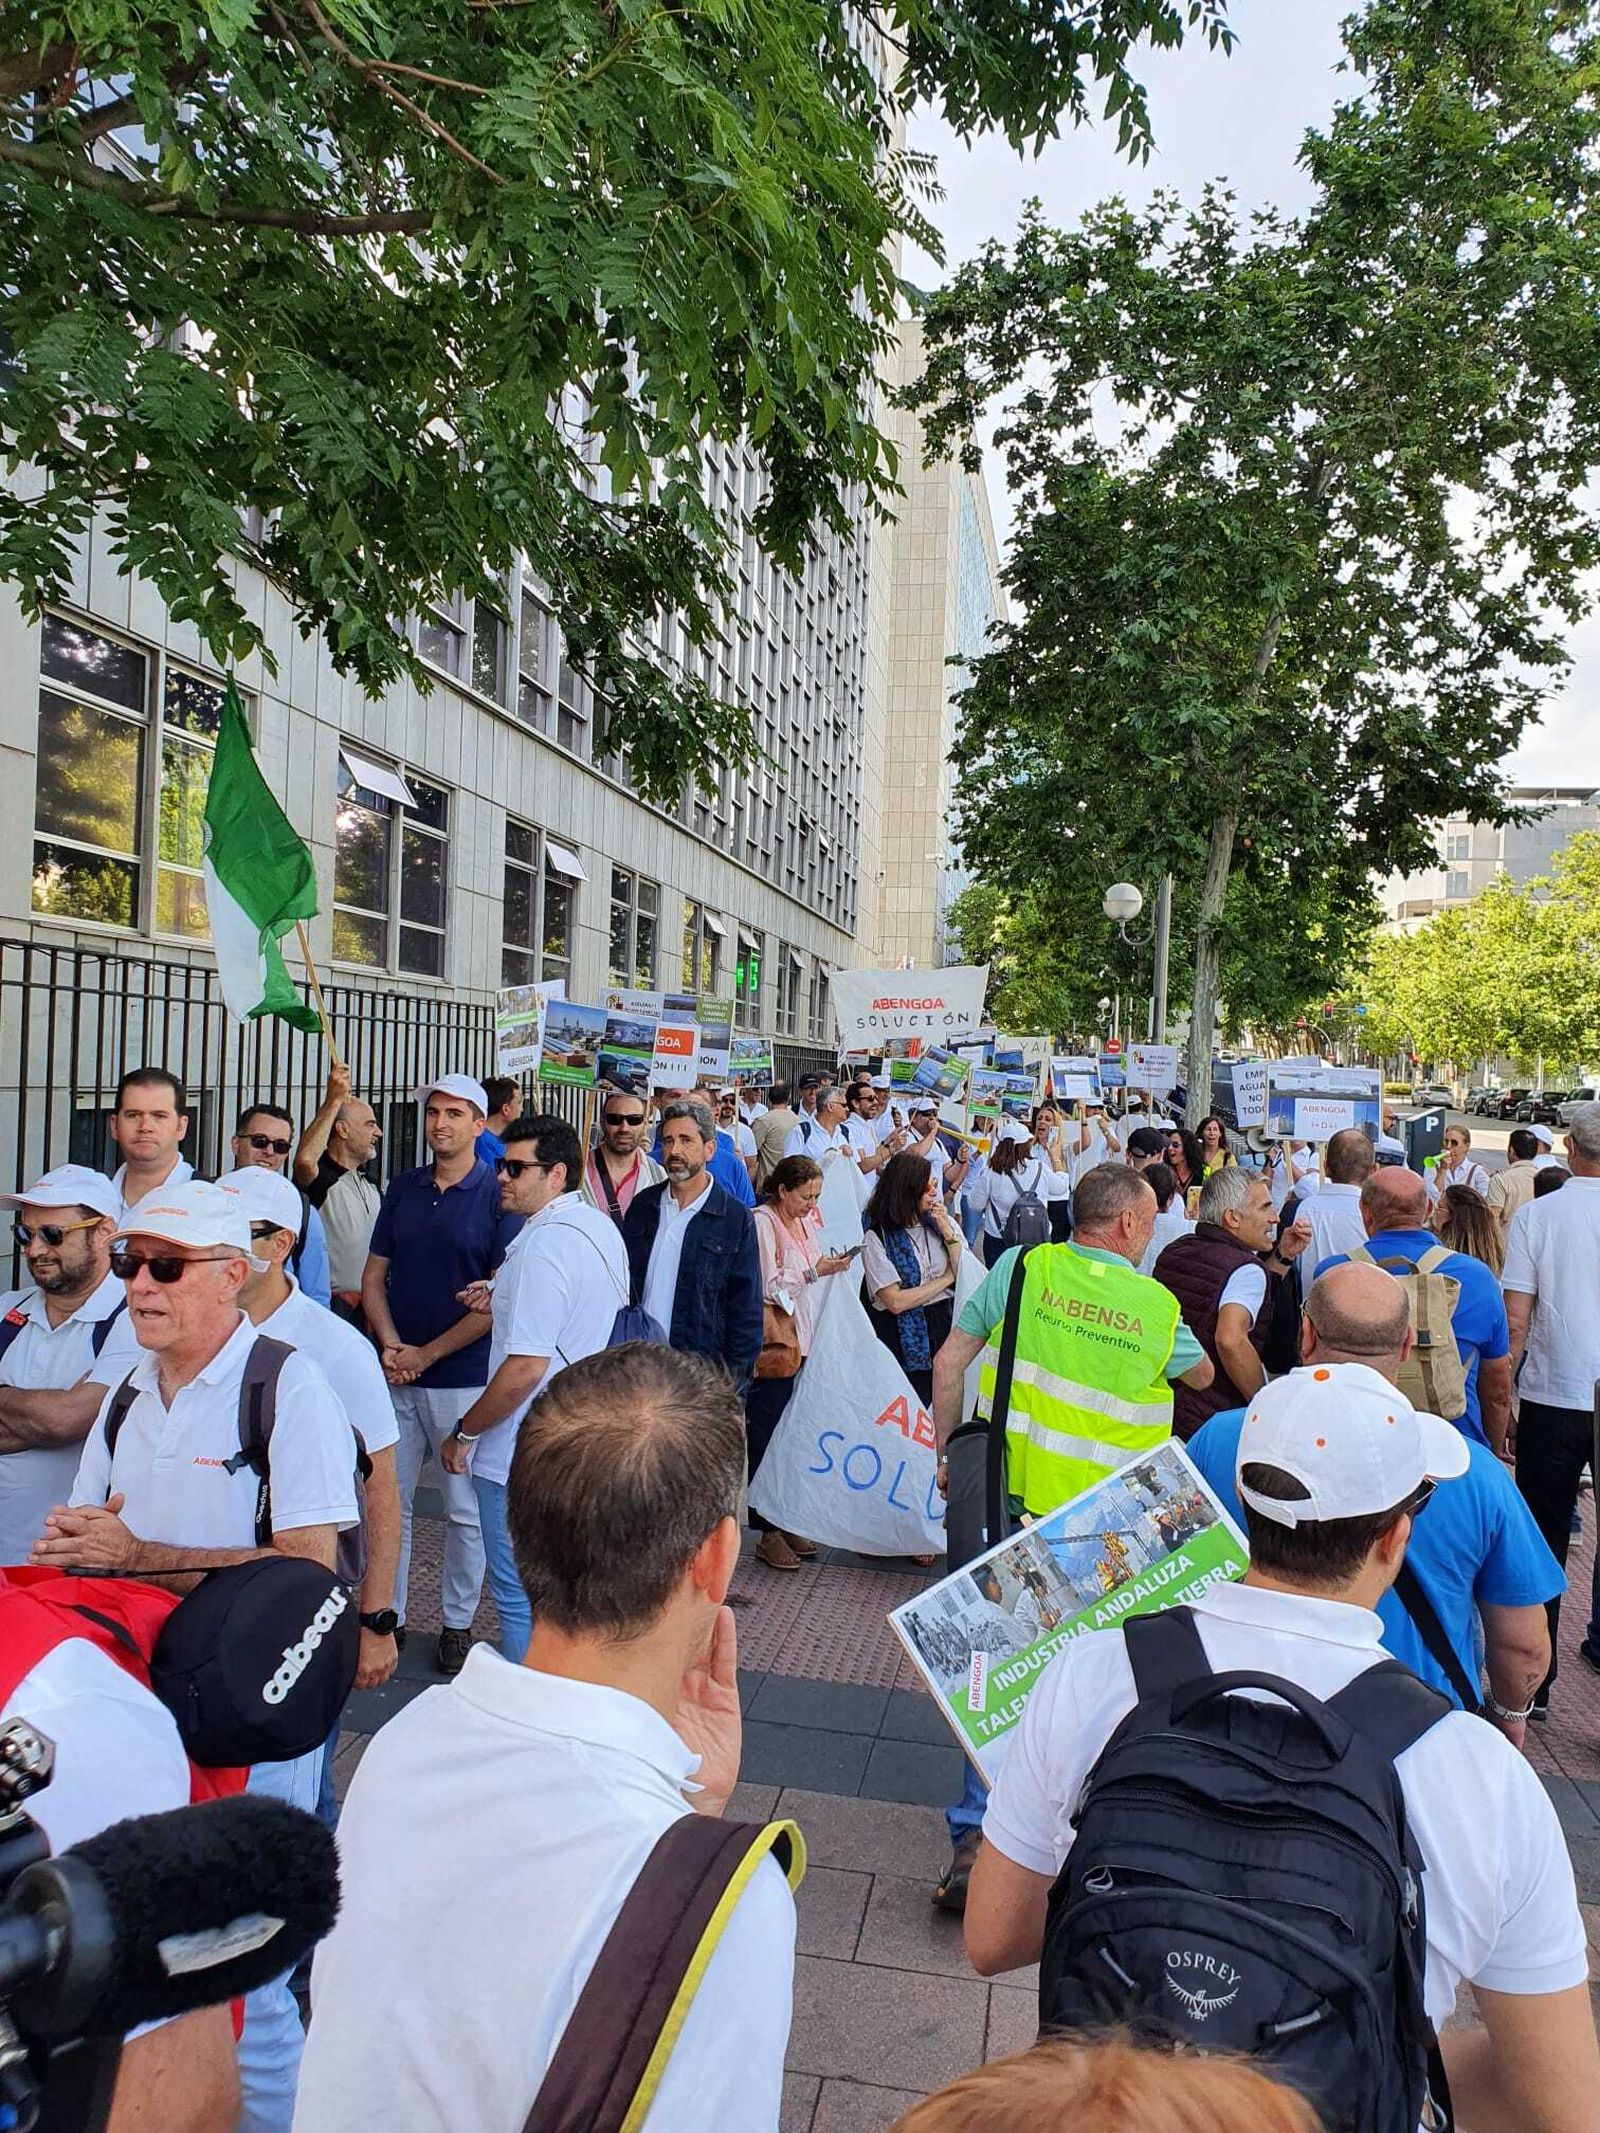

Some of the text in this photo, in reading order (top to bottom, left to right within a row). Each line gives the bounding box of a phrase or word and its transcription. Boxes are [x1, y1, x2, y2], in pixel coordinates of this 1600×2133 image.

[872, 997, 945, 1011] ABENGOA
[857, 1012, 969, 1029] SOLUCIÓN
[1240, 1082, 1266, 1091] AGUA
[1249, 1094, 1263, 1102] NO
[1426, 1117, 1440, 1132] P
[1040, 1286, 1144, 1338] NABENSA
[1075, 1325, 1141, 1353] Preventivo
[1173, 1558, 1242, 1602] TIERRA
[993, 1554, 1195, 1692] INDUSTRIA ANDALUZA
[262, 1586, 348, 1705] cabeau
[971, 1653, 984, 1709] ABENGOA
[1166, 1951, 1242, 1986] OSPREY
